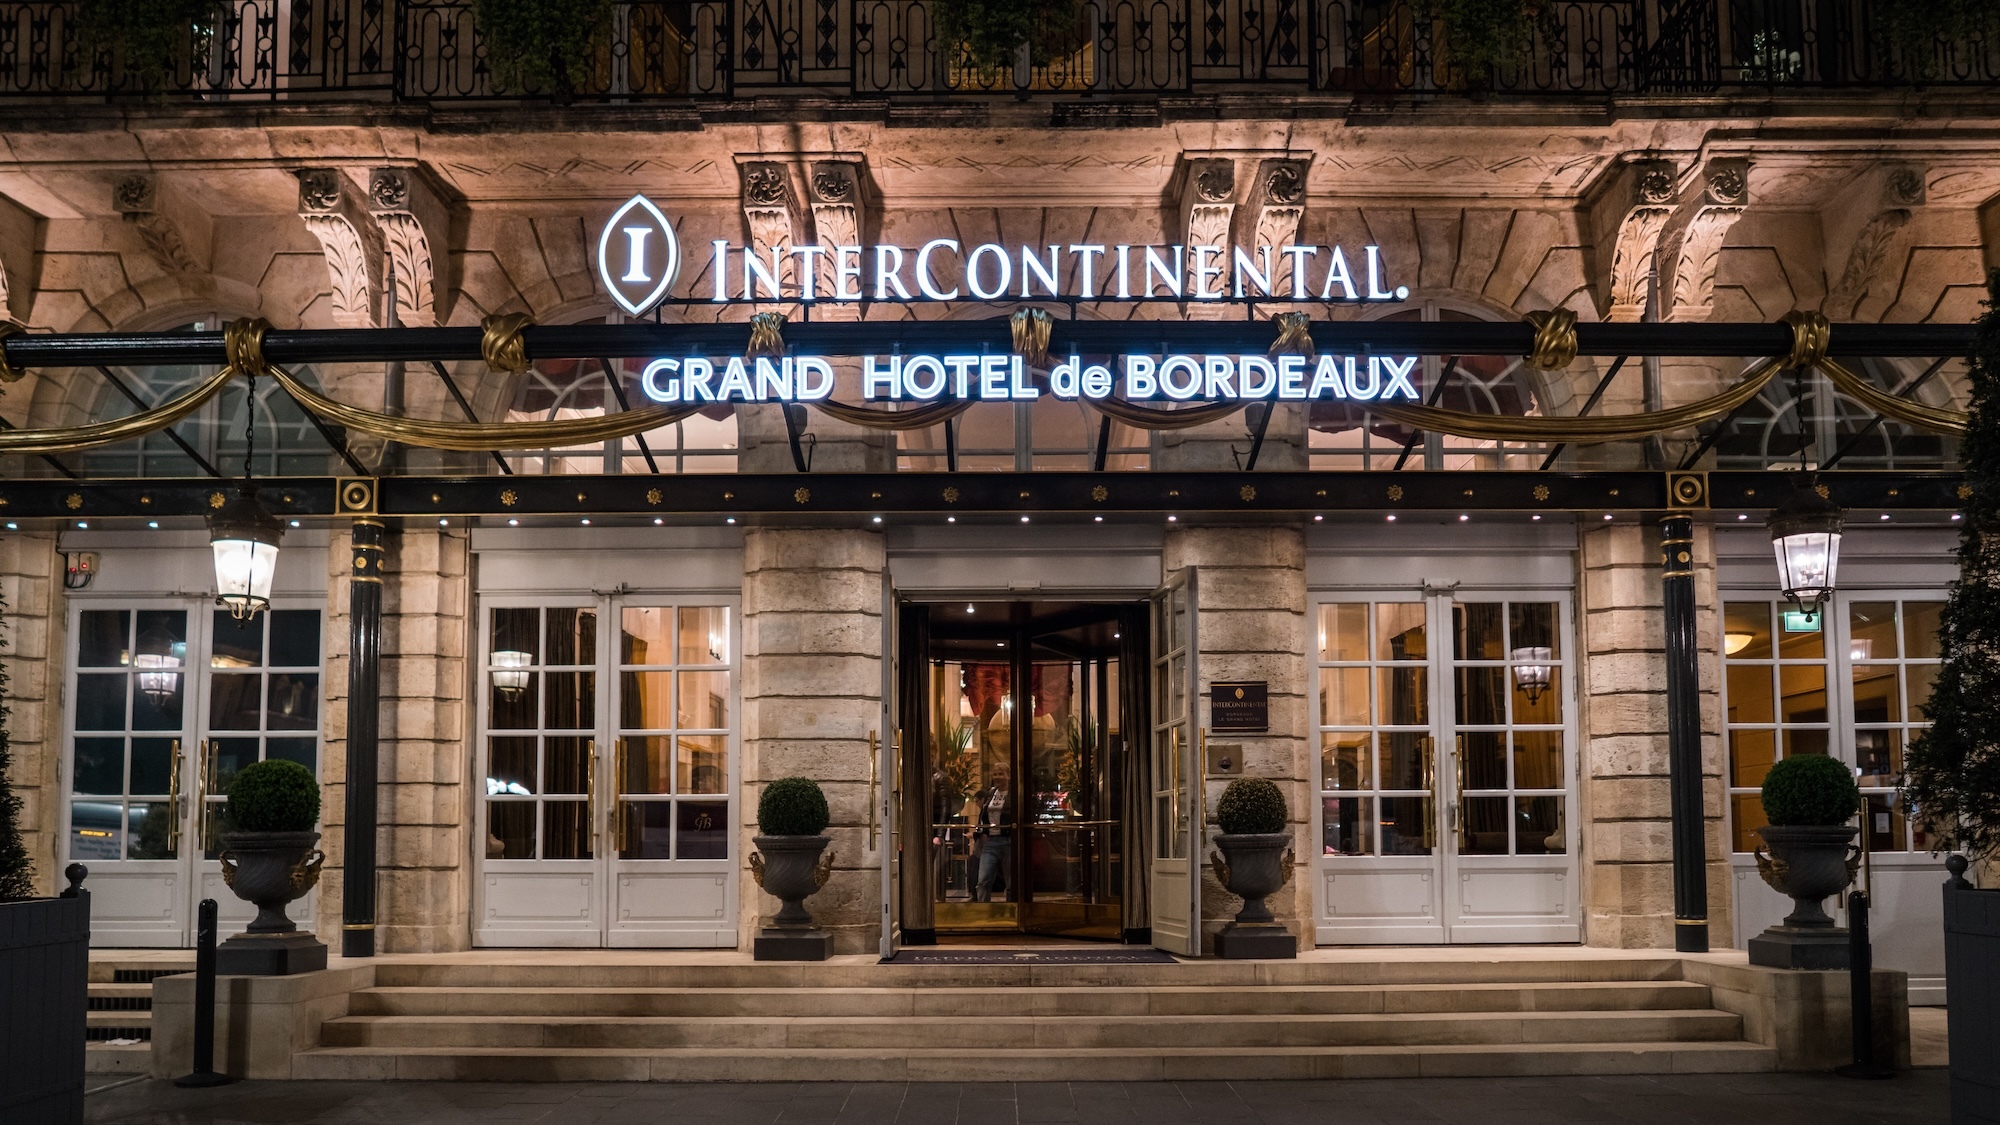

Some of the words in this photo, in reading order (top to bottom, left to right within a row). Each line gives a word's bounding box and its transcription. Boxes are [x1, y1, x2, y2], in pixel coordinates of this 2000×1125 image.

[642, 356, 834, 402] GRAND
[863, 355, 1039, 399] HOTEL
[1050, 355, 1112, 399] de
[1126, 354, 1419, 400] BORDEAUX
